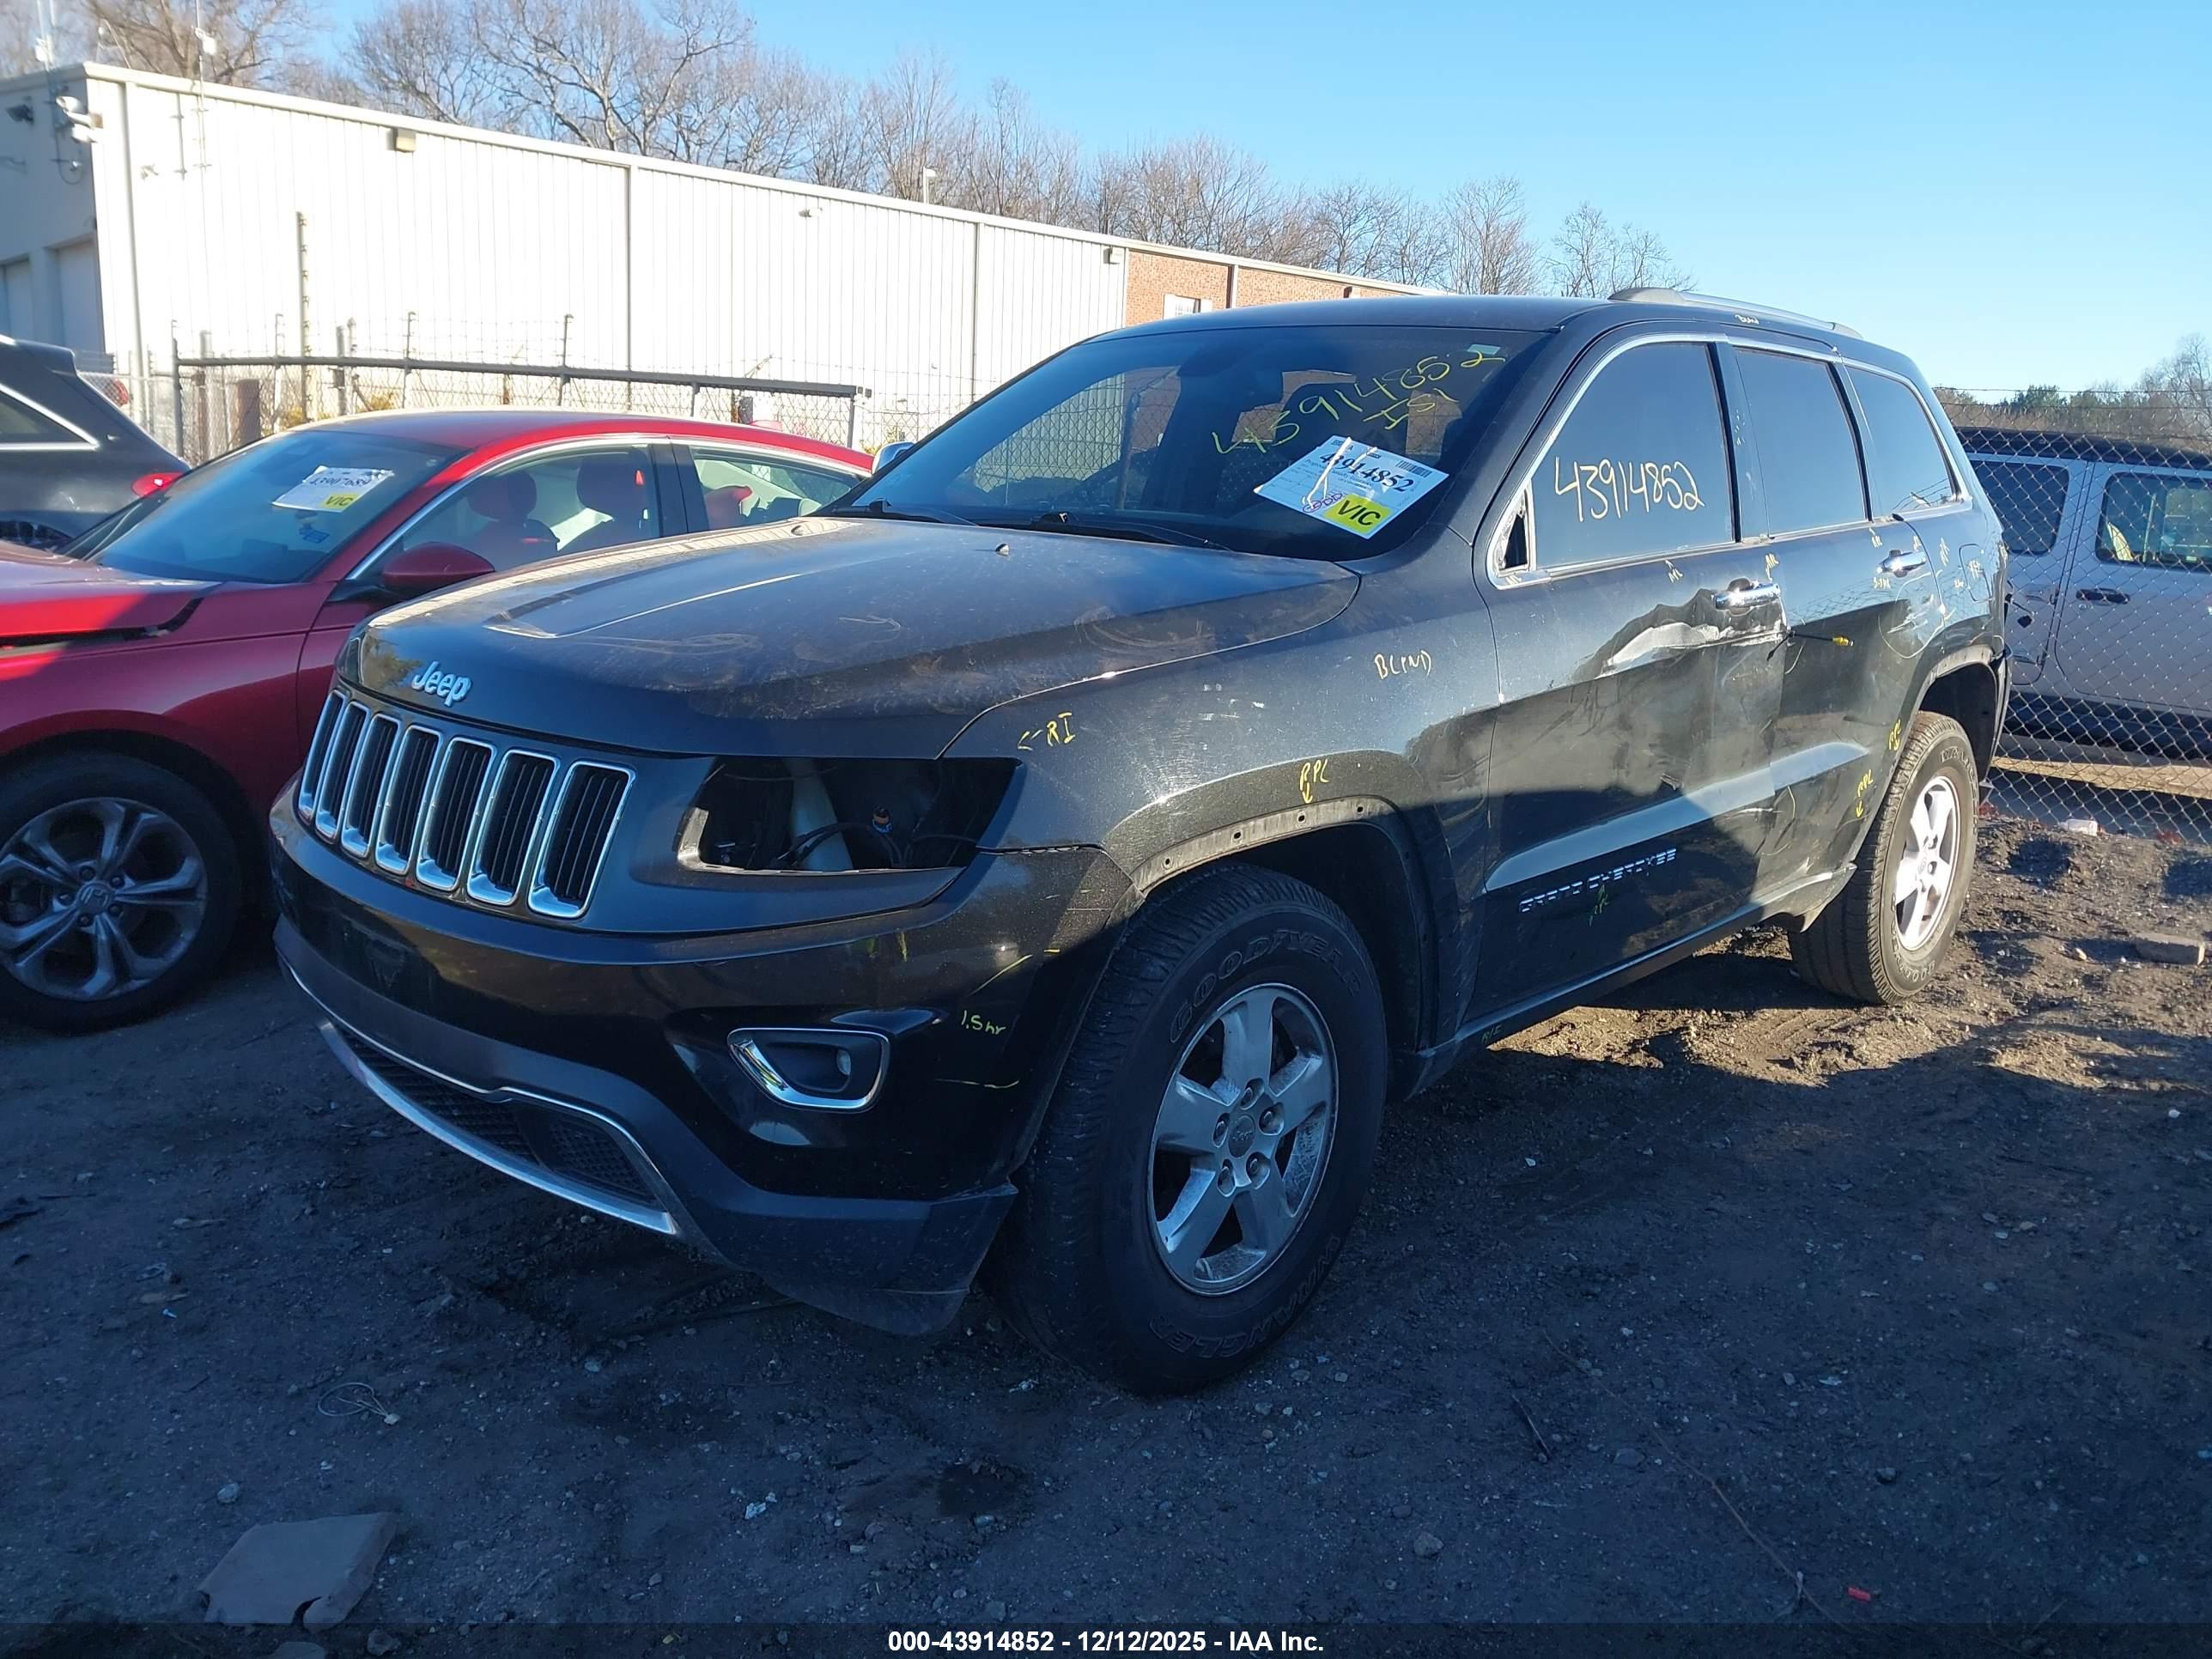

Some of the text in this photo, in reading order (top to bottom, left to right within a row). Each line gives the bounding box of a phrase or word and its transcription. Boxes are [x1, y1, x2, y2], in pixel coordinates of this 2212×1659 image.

[325, 495, 354, 507] VIC
[1337, 500, 1382, 526] VIC
[1554, 456, 1705, 523] 43914852
[411, 660, 472, 708] Jeep
[1170, 927, 1362, 1044] GOODYEAR
